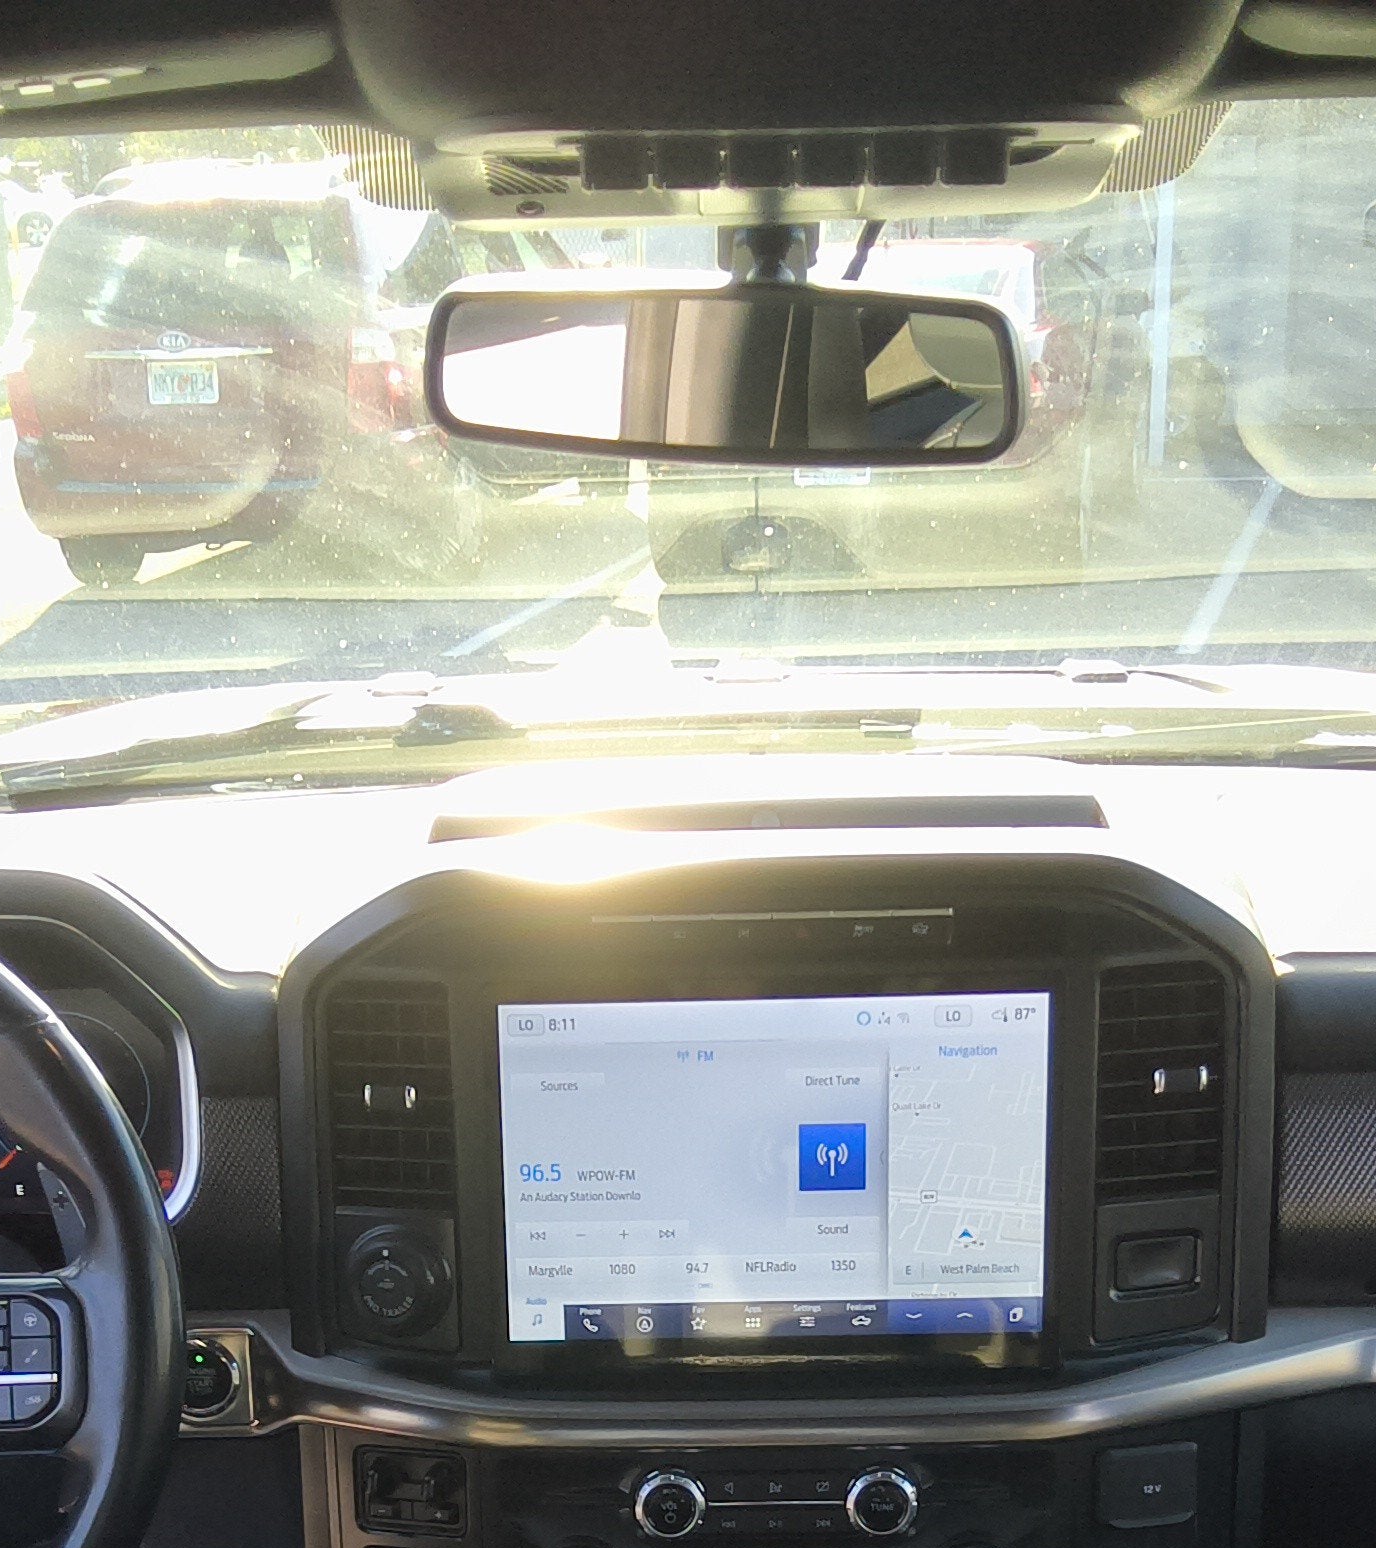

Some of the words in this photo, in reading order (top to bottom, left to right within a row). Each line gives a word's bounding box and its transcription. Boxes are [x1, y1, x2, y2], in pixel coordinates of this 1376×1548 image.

[162, 335, 187, 347] KIA
[945, 1010, 961, 1022] LO
[518, 1019, 534, 1031] LO
[548, 1018, 576, 1031] 8:11
[697, 1050, 714, 1062] FM
[938, 1044, 998, 1058] Navigation
[540, 1080, 579, 1092] Sources
[805, 1075, 834, 1087] Direct
[836, 1075, 860, 1086] Tune
[519, 1163, 562, 1182] 96.5
[577, 1169, 636, 1181] WPOW-FM
[520, 1192, 533, 1202] An
[570, 1191, 604, 1202] Station
[817, 1224, 849, 1235] Sound
[686, 1263, 709, 1274] 94.7
[745, 1261, 796, 1273] NFLRadio
[831, 1259, 856, 1271] 1350
[940, 1264, 964, 1275] West
[966, 1264, 990, 1275] Palm
[991, 1263, 1020, 1275] Beach
[793, 1303, 822, 1314] Settings
[846, 1302, 877, 1312] Features
